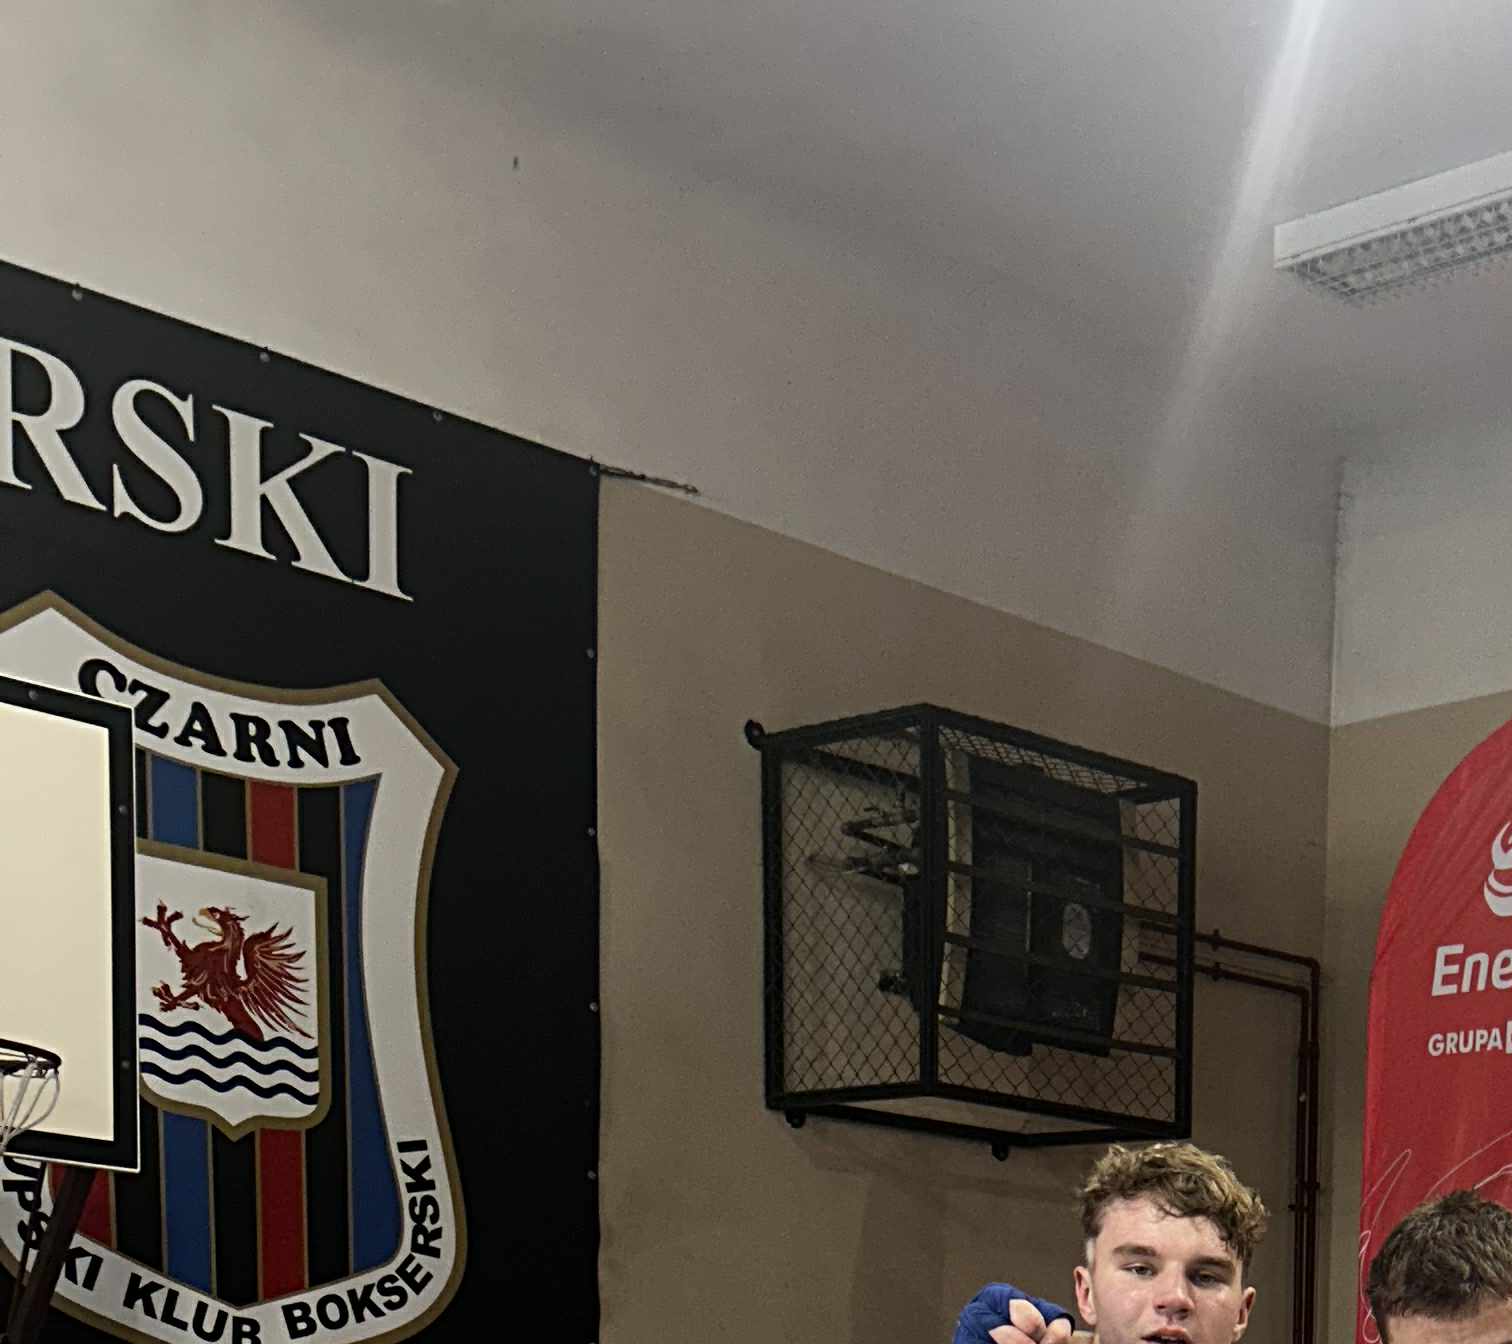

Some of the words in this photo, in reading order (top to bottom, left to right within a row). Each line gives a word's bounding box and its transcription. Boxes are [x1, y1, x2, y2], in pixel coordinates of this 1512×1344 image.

[0, 337, 413, 601] RSKI
[78, 657, 361, 768] CZARNI
[1428, 1027, 1502, 1056] GRUPA
[283, 1139, 441, 1340] BOKSERSKI
